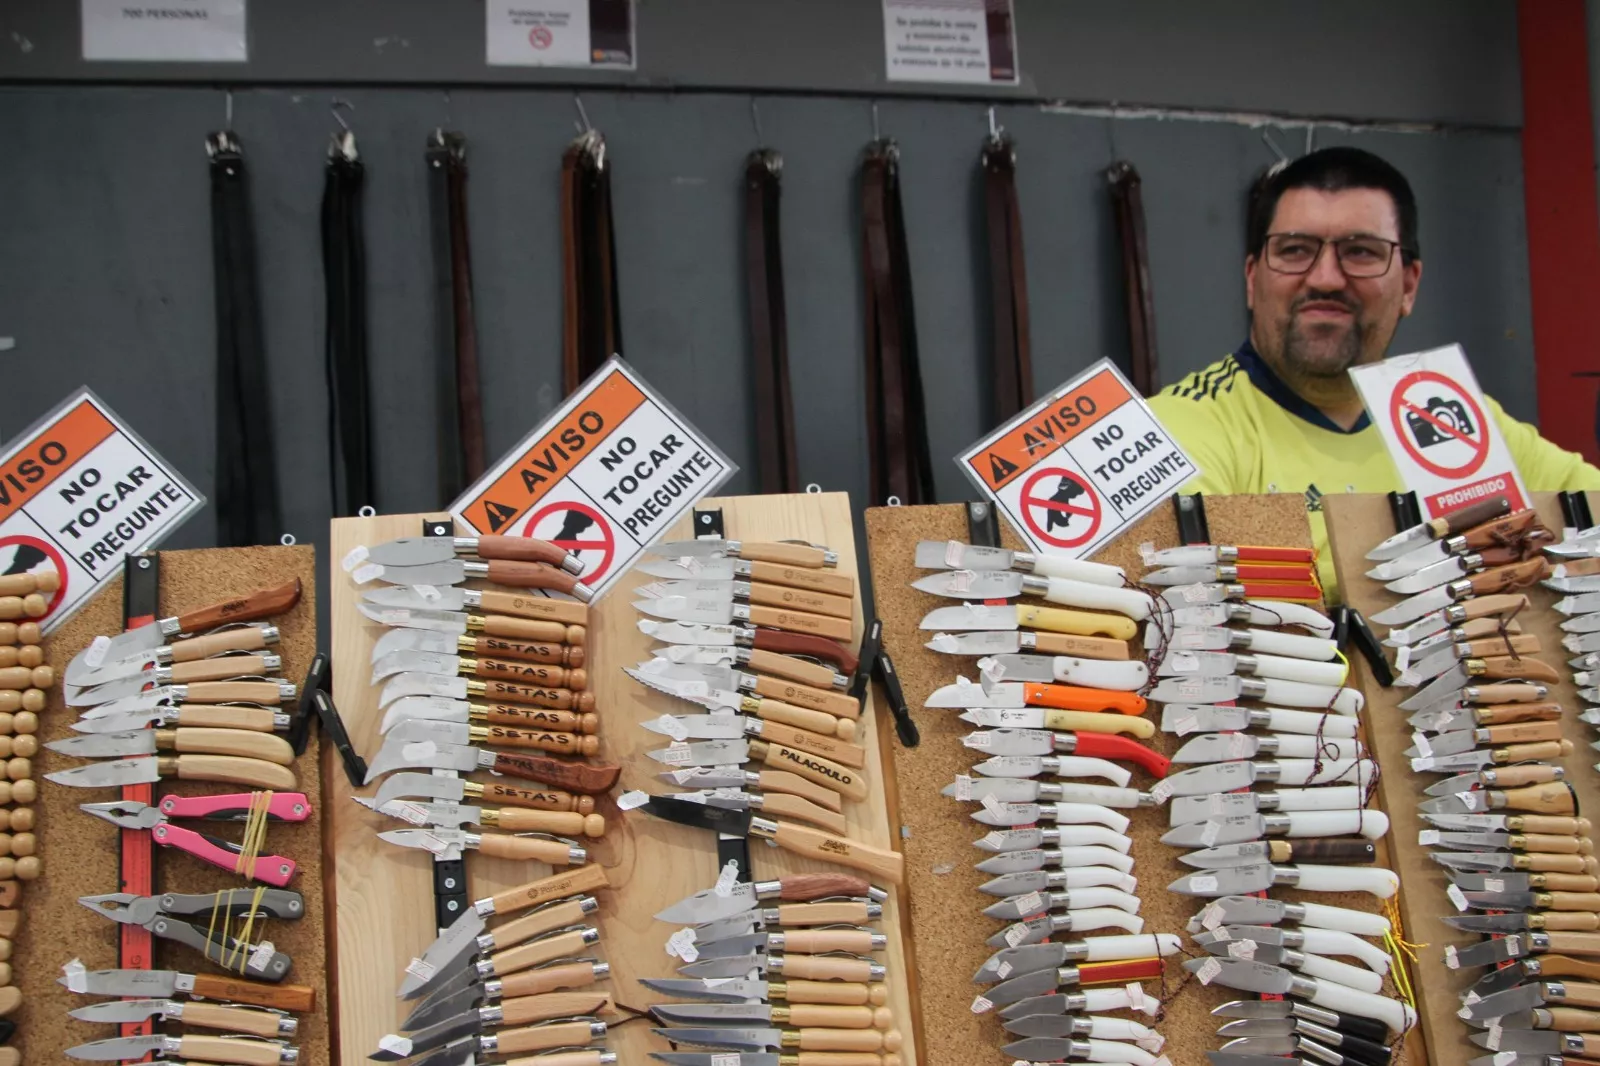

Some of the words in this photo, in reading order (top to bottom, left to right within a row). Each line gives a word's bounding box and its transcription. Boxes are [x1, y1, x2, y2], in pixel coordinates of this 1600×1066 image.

[1022, 396, 1097, 456] AVISO
[1092, 424, 1124, 451] NO
[520, 410, 604, 494] AVISO
[599, 436, 637, 472] NO
[603, 433, 685, 506] TOCAR
[1093, 431, 1163, 482] TOCAR
[58, 468, 102, 505] NO
[623, 451, 712, 536] PREGUNTE
[1110, 451, 1186, 511] PREGUNTE
[1436, 479, 1506, 509] PROHIBIDO
[59, 465, 154, 540] TOCAR
[79, 483, 182, 572] PREGUNTE
[487, 639, 550, 656] SETAS
[484, 660, 549, 678] SETAS
[495, 683, 559, 700] SETAS
[496, 705, 560, 723] SETAS
[492, 727, 570, 744] SETAS
[780, 748, 852, 786] PALACOULO
[494, 785, 559, 804] SETAS
[540, 880, 573, 895] Portugal
